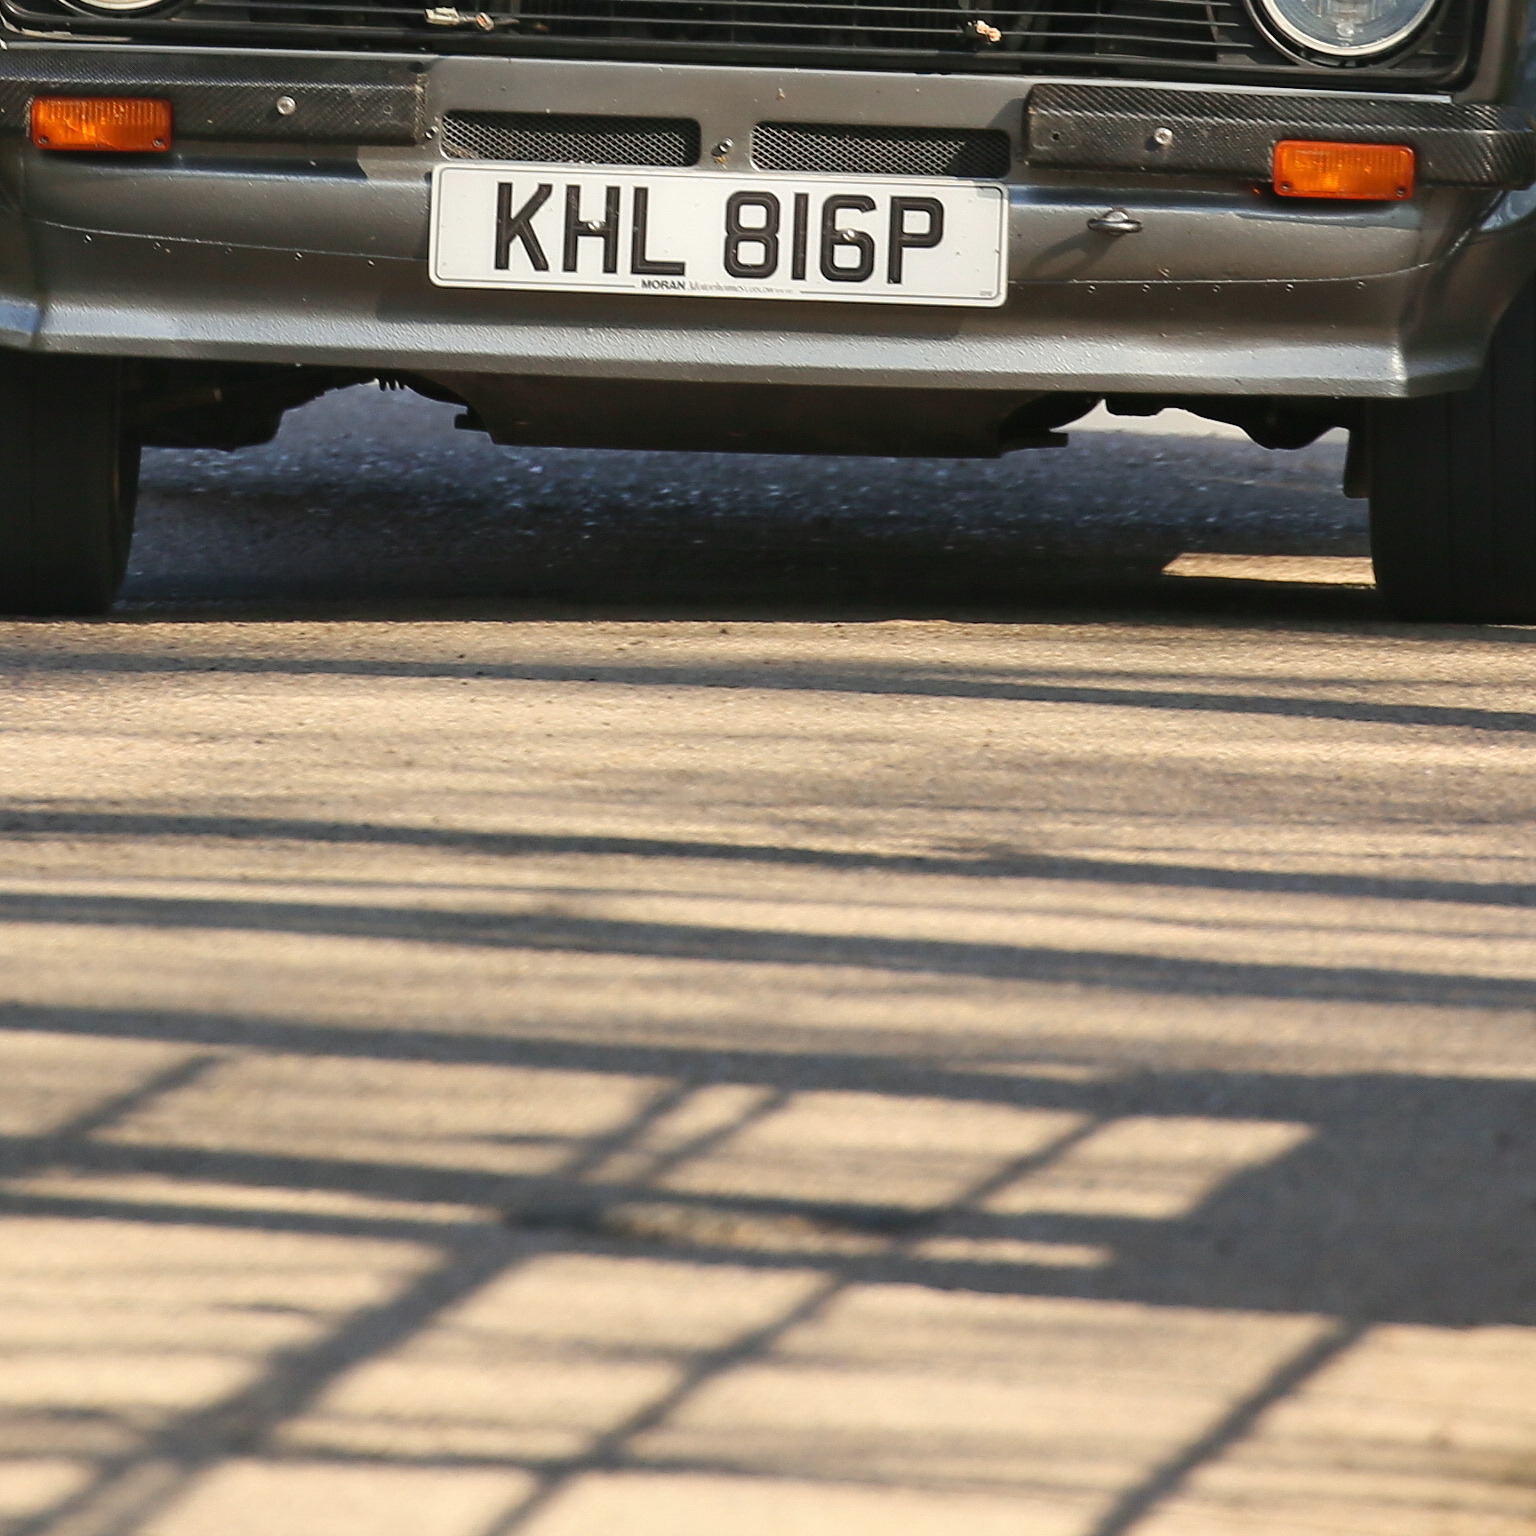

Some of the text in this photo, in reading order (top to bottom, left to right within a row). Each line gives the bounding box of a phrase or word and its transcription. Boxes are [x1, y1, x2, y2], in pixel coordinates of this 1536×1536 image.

[494, 181, 946, 286] KHL 816P
[640, 279, 686, 291] MORAN
